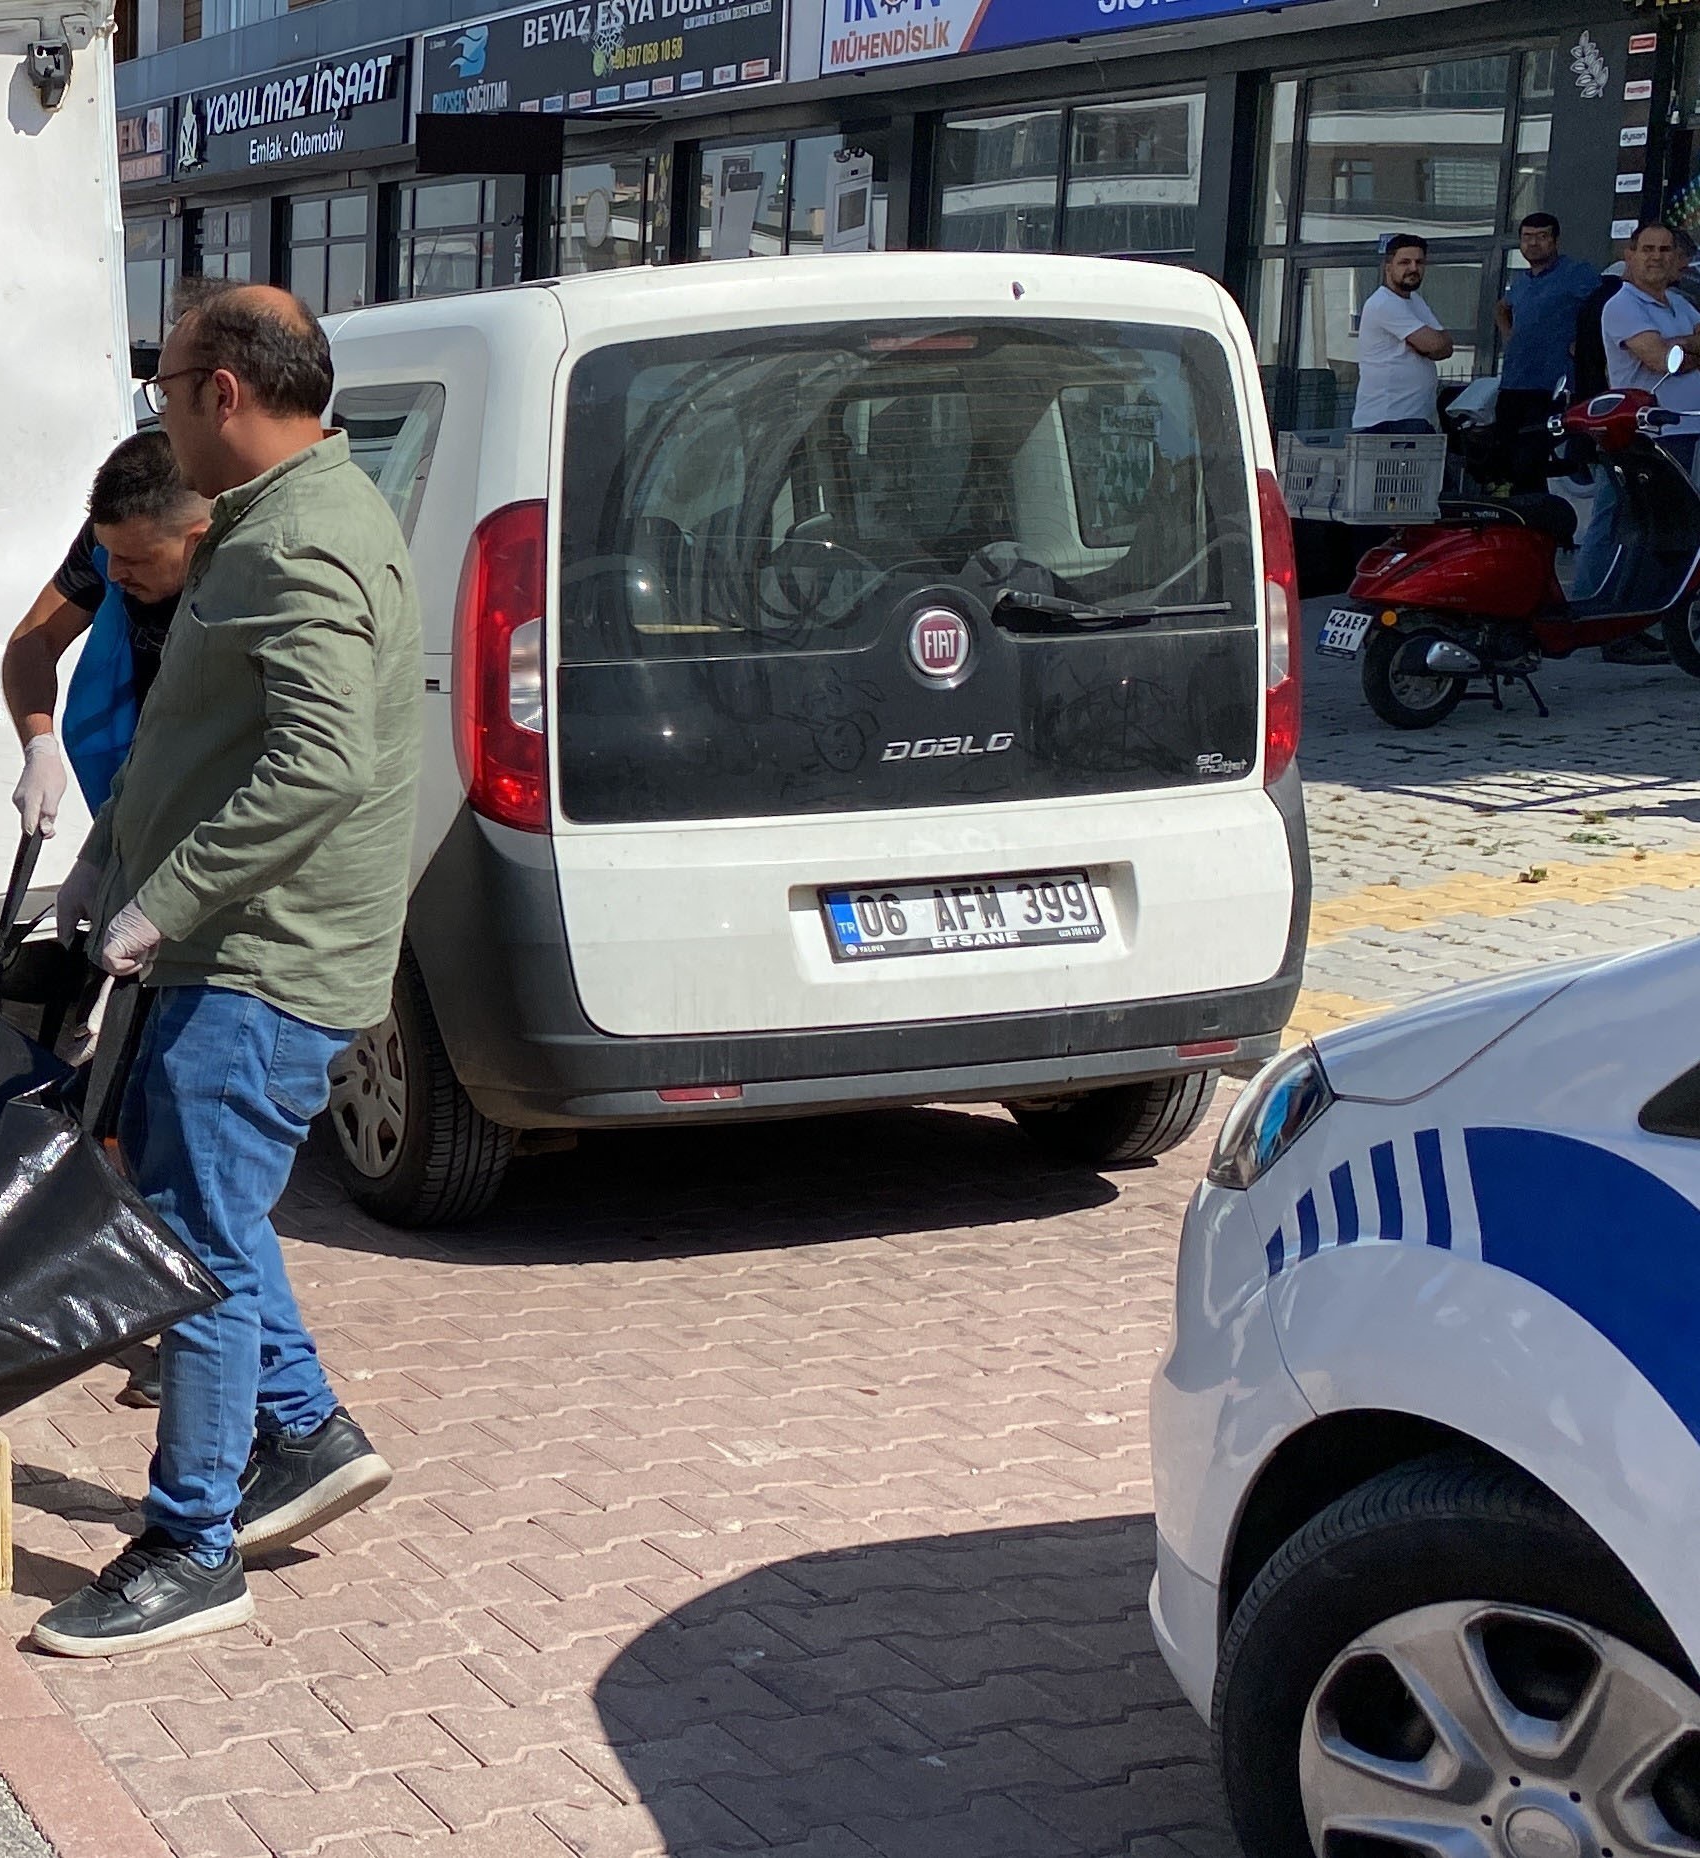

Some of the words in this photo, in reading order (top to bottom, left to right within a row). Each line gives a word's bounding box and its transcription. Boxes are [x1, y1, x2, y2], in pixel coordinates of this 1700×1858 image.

[523, 5, 591, 48] BEYAZ
[830, 16, 951, 65] MÜHENDİSLİK
[206, 74, 309, 135] YORULMAZ
[310, 54, 393, 120] İNŞAAT
[250, 137, 282, 165] Emlak
[290, 123, 344, 158] Otomotiv
[1621, 131, 1646, 143] dyson
[923, 628, 958, 659] FIAT
[1328, 630, 1353, 647] 611
[855, 893, 908, 937] 06
[932, 885, 1007, 932] AFM
[1016, 880, 1089, 924] 399
[836, 921, 857, 935] TR
[931, 931, 1022, 949] EFSANE
